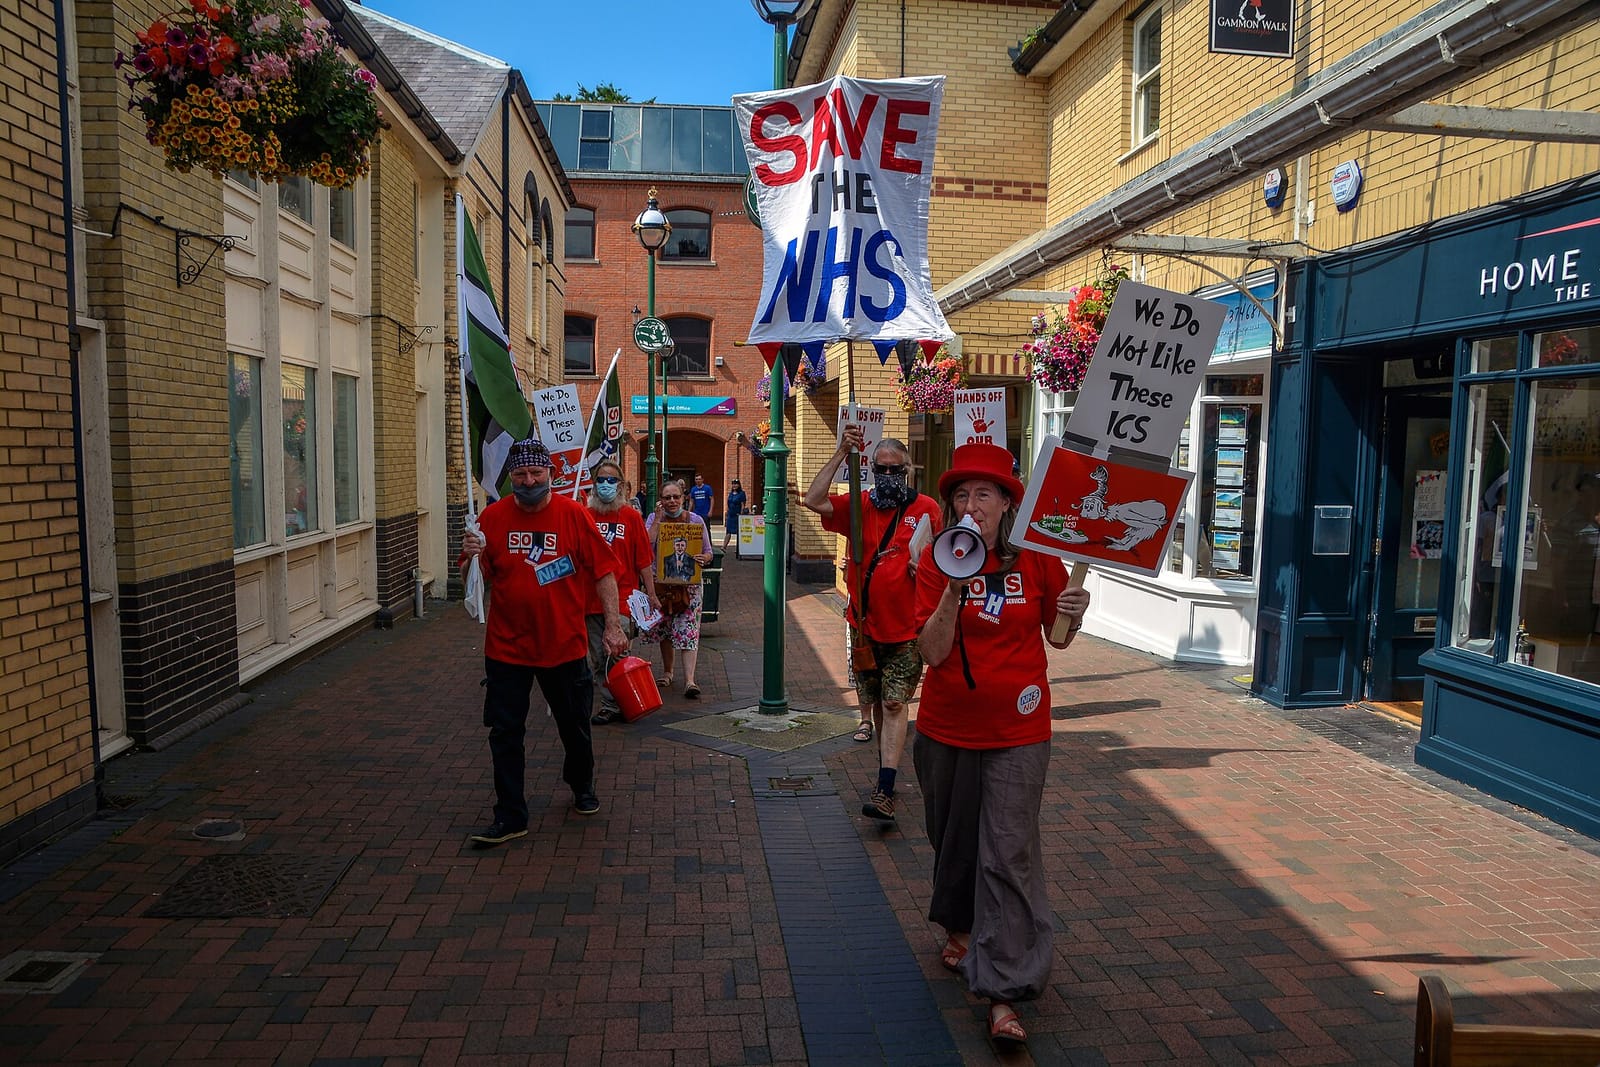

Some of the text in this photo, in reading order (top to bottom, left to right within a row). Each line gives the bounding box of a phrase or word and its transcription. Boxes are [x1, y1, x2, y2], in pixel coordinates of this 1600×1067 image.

[1217, 16, 1287, 31] GAMMON WALK
[750, 88, 931, 187] SAVE
[811, 170, 878, 214] THE
[759, 227, 907, 324] NHS
[1480, 249, 1581, 296] HOME
[1554, 283, 1591, 302] THE
[1135, 298, 1165, 328] We
[1170, 303, 1200, 336] Do
[1107, 331, 1196, 376] Not Like
[540, 389, 570, 402] We Do
[956, 391, 1003, 404] HANDS OFF
[1109, 371, 1173, 408] These
[541, 402, 577, 418] Not Like
[869, 411, 883, 423] OFF
[547, 419, 576, 431] These
[555, 430, 573, 443] ICS
[1106, 410, 1151, 443] ICS
[538, 558, 568, 583] NHS
